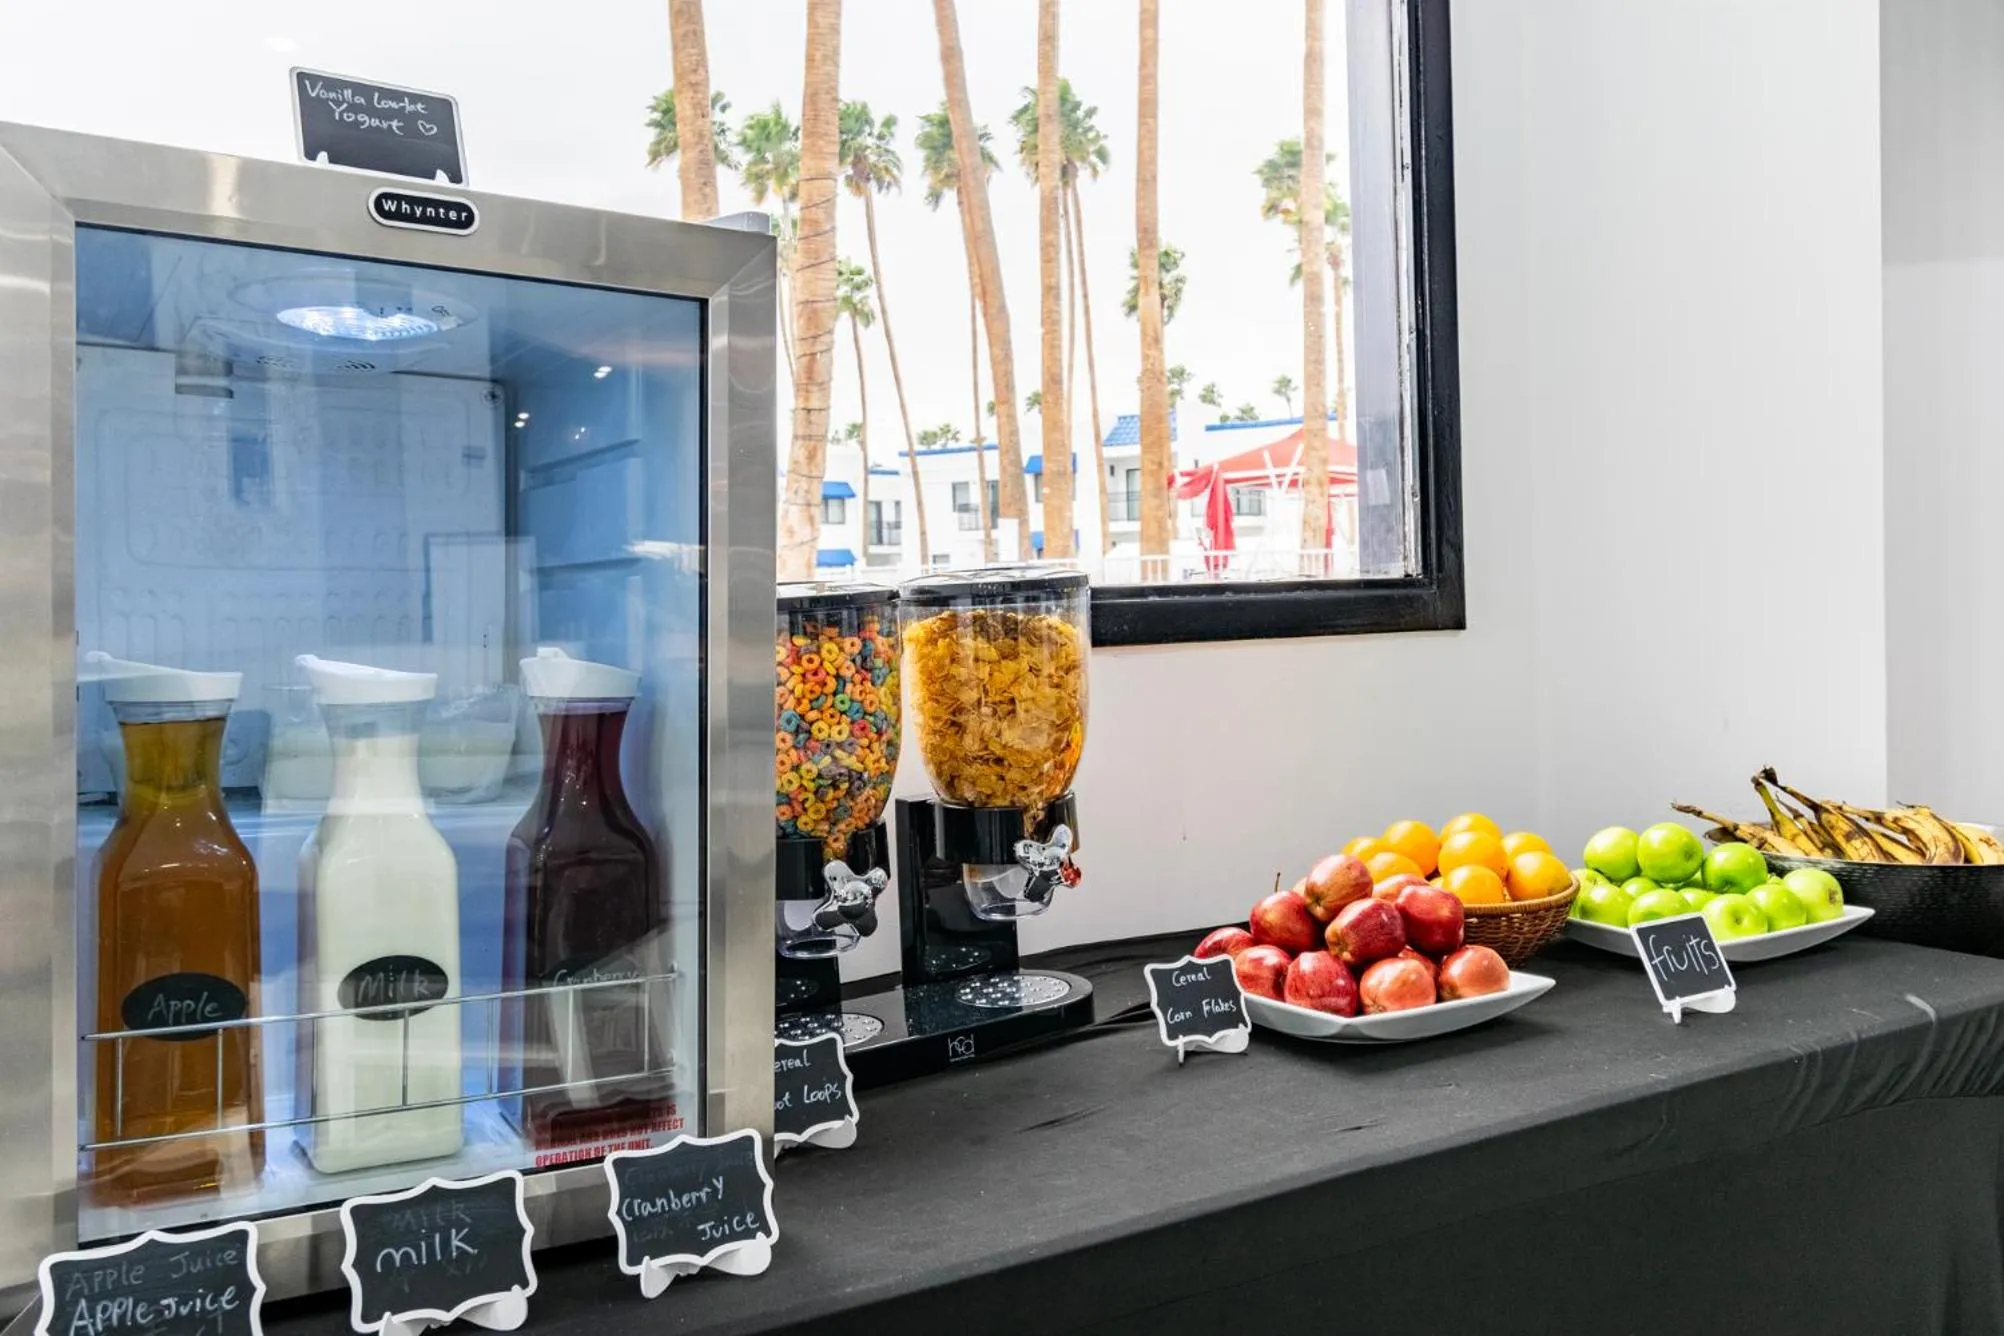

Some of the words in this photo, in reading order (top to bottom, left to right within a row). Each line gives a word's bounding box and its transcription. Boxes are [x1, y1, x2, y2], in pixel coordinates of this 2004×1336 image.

[304, 79, 366, 106] Vanilla
[381, 198, 469, 221] Whynter
[1649, 934, 1720, 982] fruits
[358, 964, 430, 1003] Milk
[1172, 966, 1212, 987] Cereal
[148, 991, 223, 1026] Apple
[1167, 1007, 1192, 1024] Corn
[1202, 998, 1237, 1018] Flakes
[774, 1048, 811, 1072] ereal
[803, 1082, 842, 1104] Loops
[535, 1147, 592, 1169] OPERATION
[621, 1175, 724, 1221] Cranberry
[697, 1210, 760, 1241] Juice
[169, 1249, 240, 1279] Juice
[160, 1285, 240, 1319] Juice
